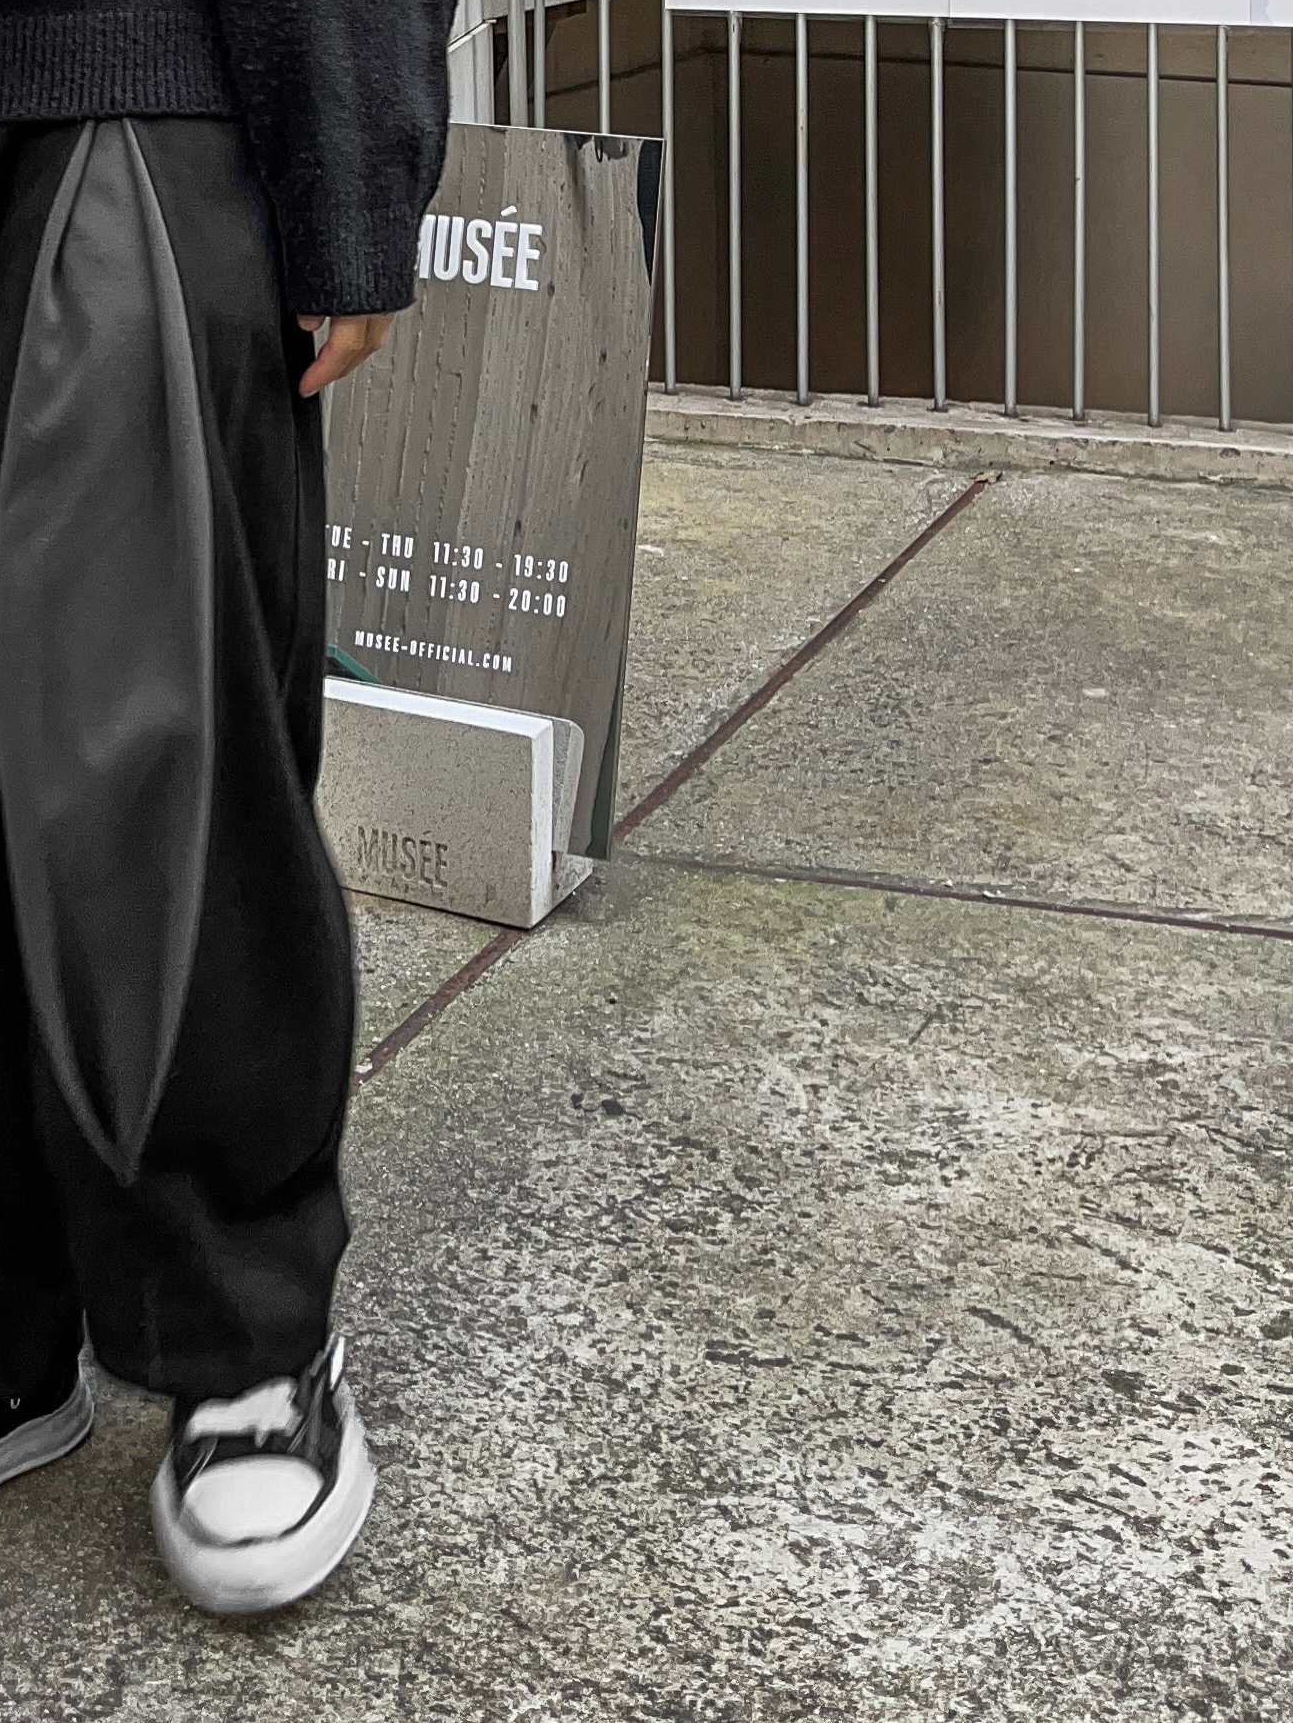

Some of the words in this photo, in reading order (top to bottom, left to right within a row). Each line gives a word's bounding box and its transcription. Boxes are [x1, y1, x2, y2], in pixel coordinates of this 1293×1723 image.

[326, 525, 353, 549] UE
[381, 533, 414, 559] THU
[433, 541, 484, 570] 11:30
[514, 554, 569, 583] 19:30
[327, 558, 345, 582] RI
[375, 566, 411, 592] SUN
[429, 575, 480, 603] 11:30
[508, 588, 566, 617] 20:00
[354, 630, 512, 672] MUSEE-OFFICIAL.COM
[357, 825, 448, 888] MUSÉE
